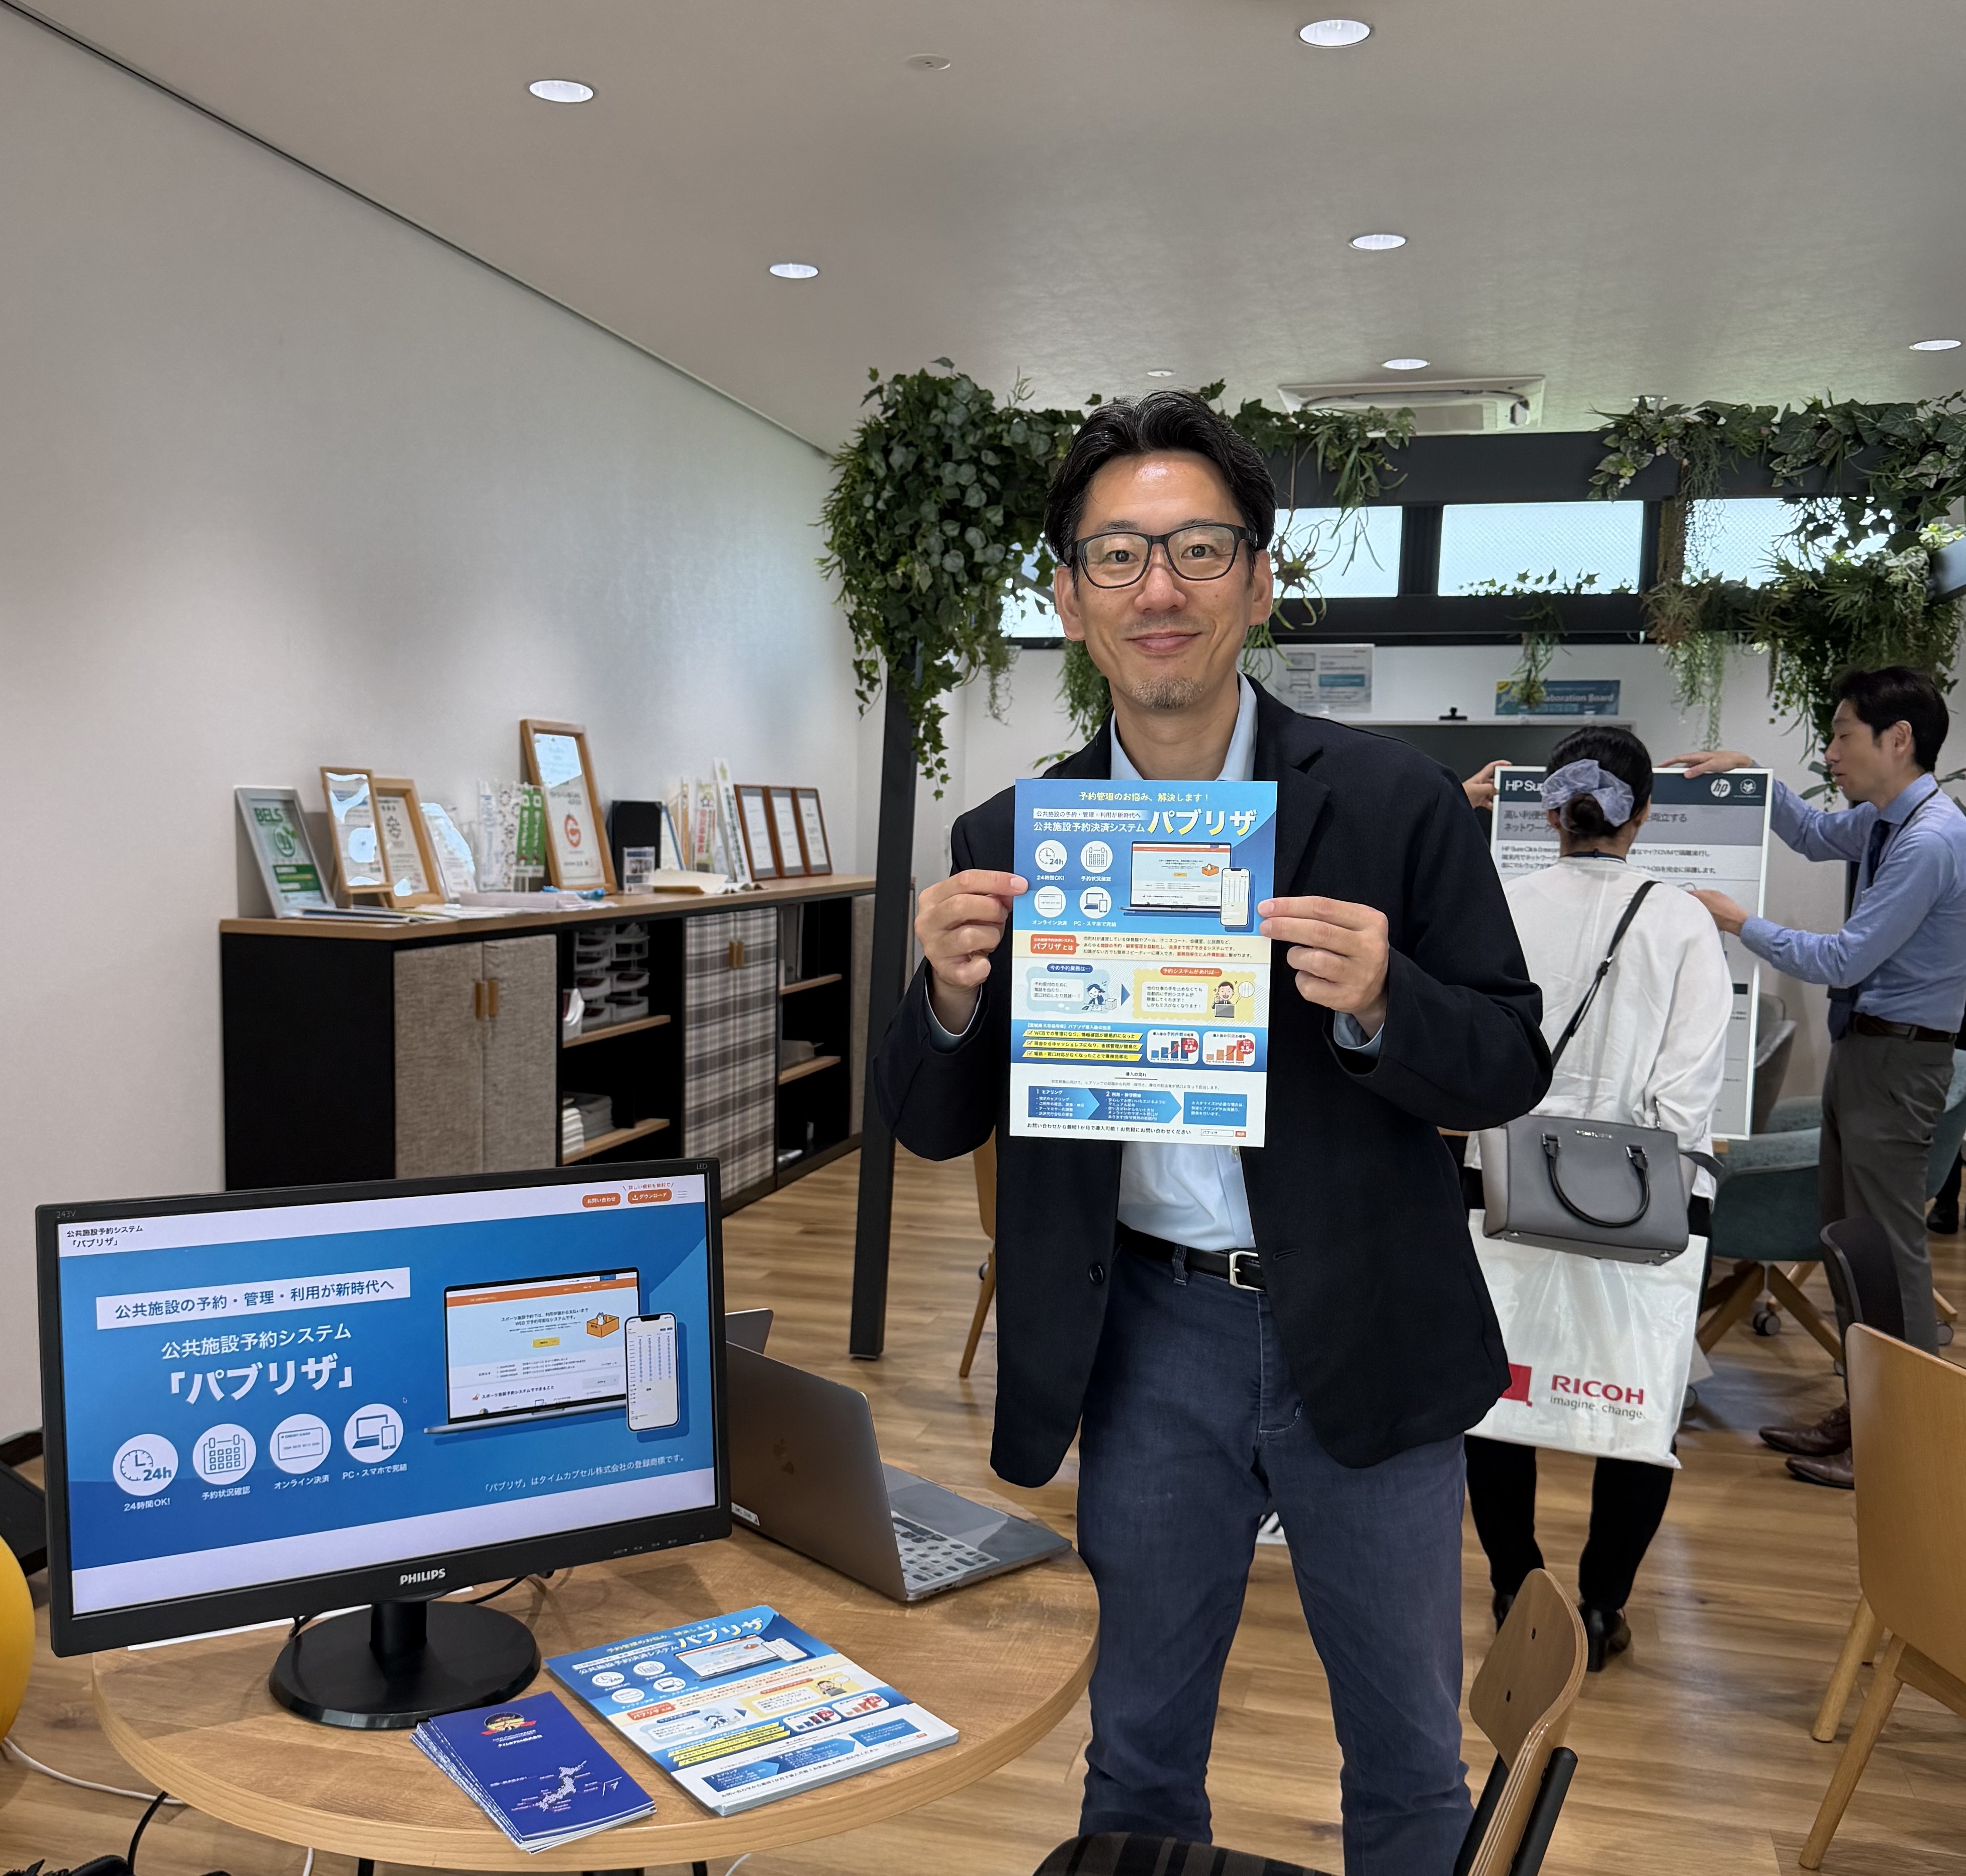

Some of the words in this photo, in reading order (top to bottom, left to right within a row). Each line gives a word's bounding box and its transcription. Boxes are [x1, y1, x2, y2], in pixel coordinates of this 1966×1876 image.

[1506, 780, 1523, 791] HP
[1711, 779, 1730, 798] hp
[254, 808, 284, 823] BELS
[1147, 809, 1257, 836] パブリザ
[1034, 822, 1145, 832] 公共施設予約決済システム
[66, 1225, 143, 1238] 公共施設予約システム
[115, 1279, 395, 1320] 公共施設の予約・管理・利用が新時代へ
[161, 1323, 352, 1361] 公共施設予約システム
[170, 1352, 353, 1405] 「パブリザ」
[1551, 1374, 1644, 1405] RICOH
[1550, 1395, 1598, 1412] imagine.
[1602, 1404, 1646, 1420] change.
[143, 1467, 172, 1481] 24h
[342, 1463, 408, 1480] PC・スマホで完結
[274, 1474, 330, 1490] オンライン決済
[202, 1486, 251, 1501] 予約状況確認
[124, 1497, 171, 1512] 24時間OK!
[400, 1567, 446, 1586] PHILIPS
[680, 1617, 763, 1649] パブリザ
